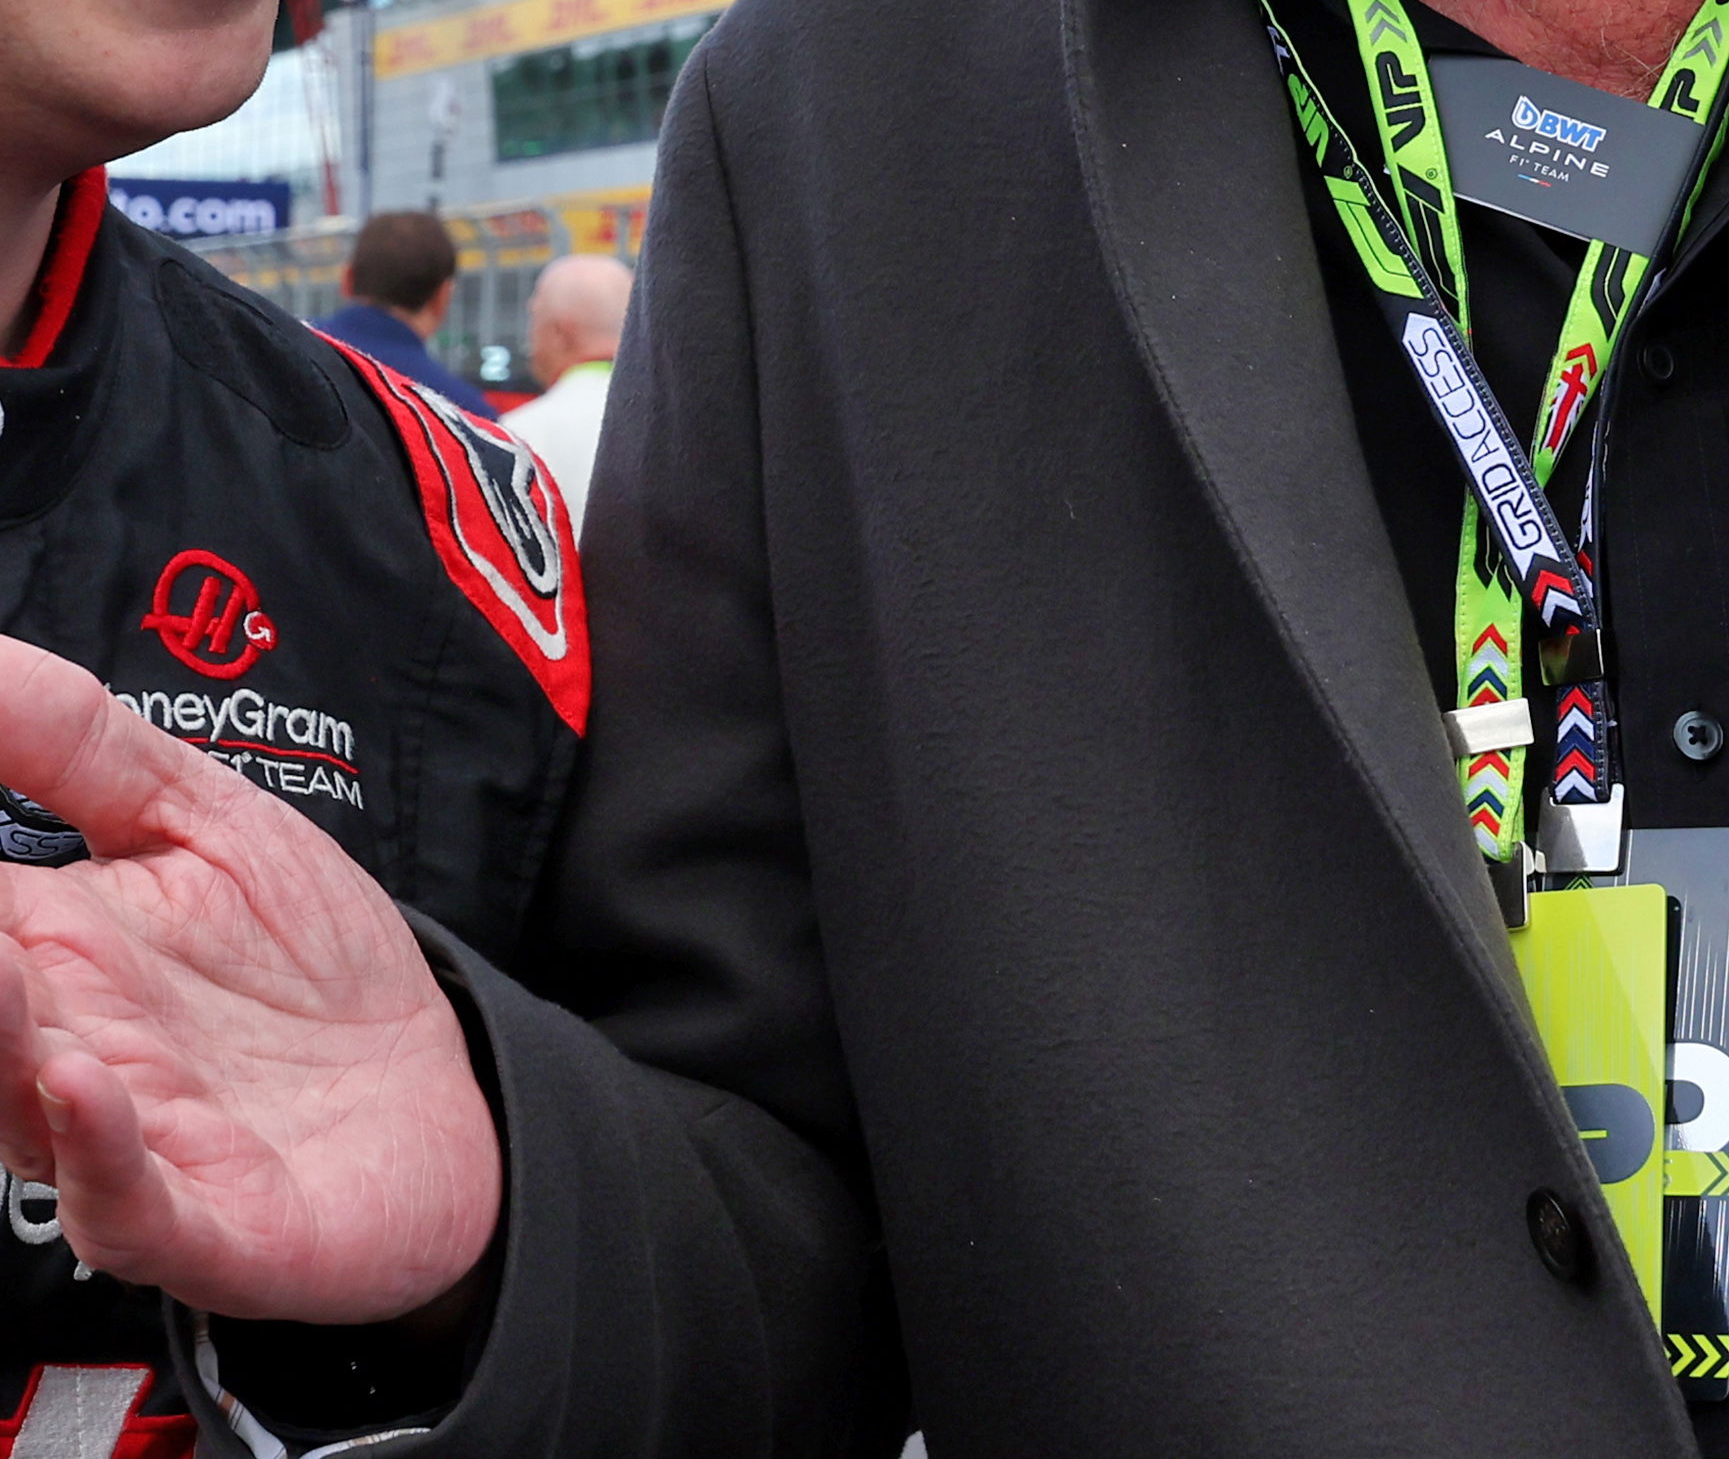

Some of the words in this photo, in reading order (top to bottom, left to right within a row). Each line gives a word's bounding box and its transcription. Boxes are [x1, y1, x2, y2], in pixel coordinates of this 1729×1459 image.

[1484, 129, 1610, 178] ALPINE
[1535, 109, 1607, 152] BWT
[1533, 162, 1570, 182] TEAM
[1408, 327, 1500, 463] ACCESS
[1481, 462, 1543, 552] GRID
[105, 683, 354, 761] oneyGram
[255, 755, 364, 810] TEAM
